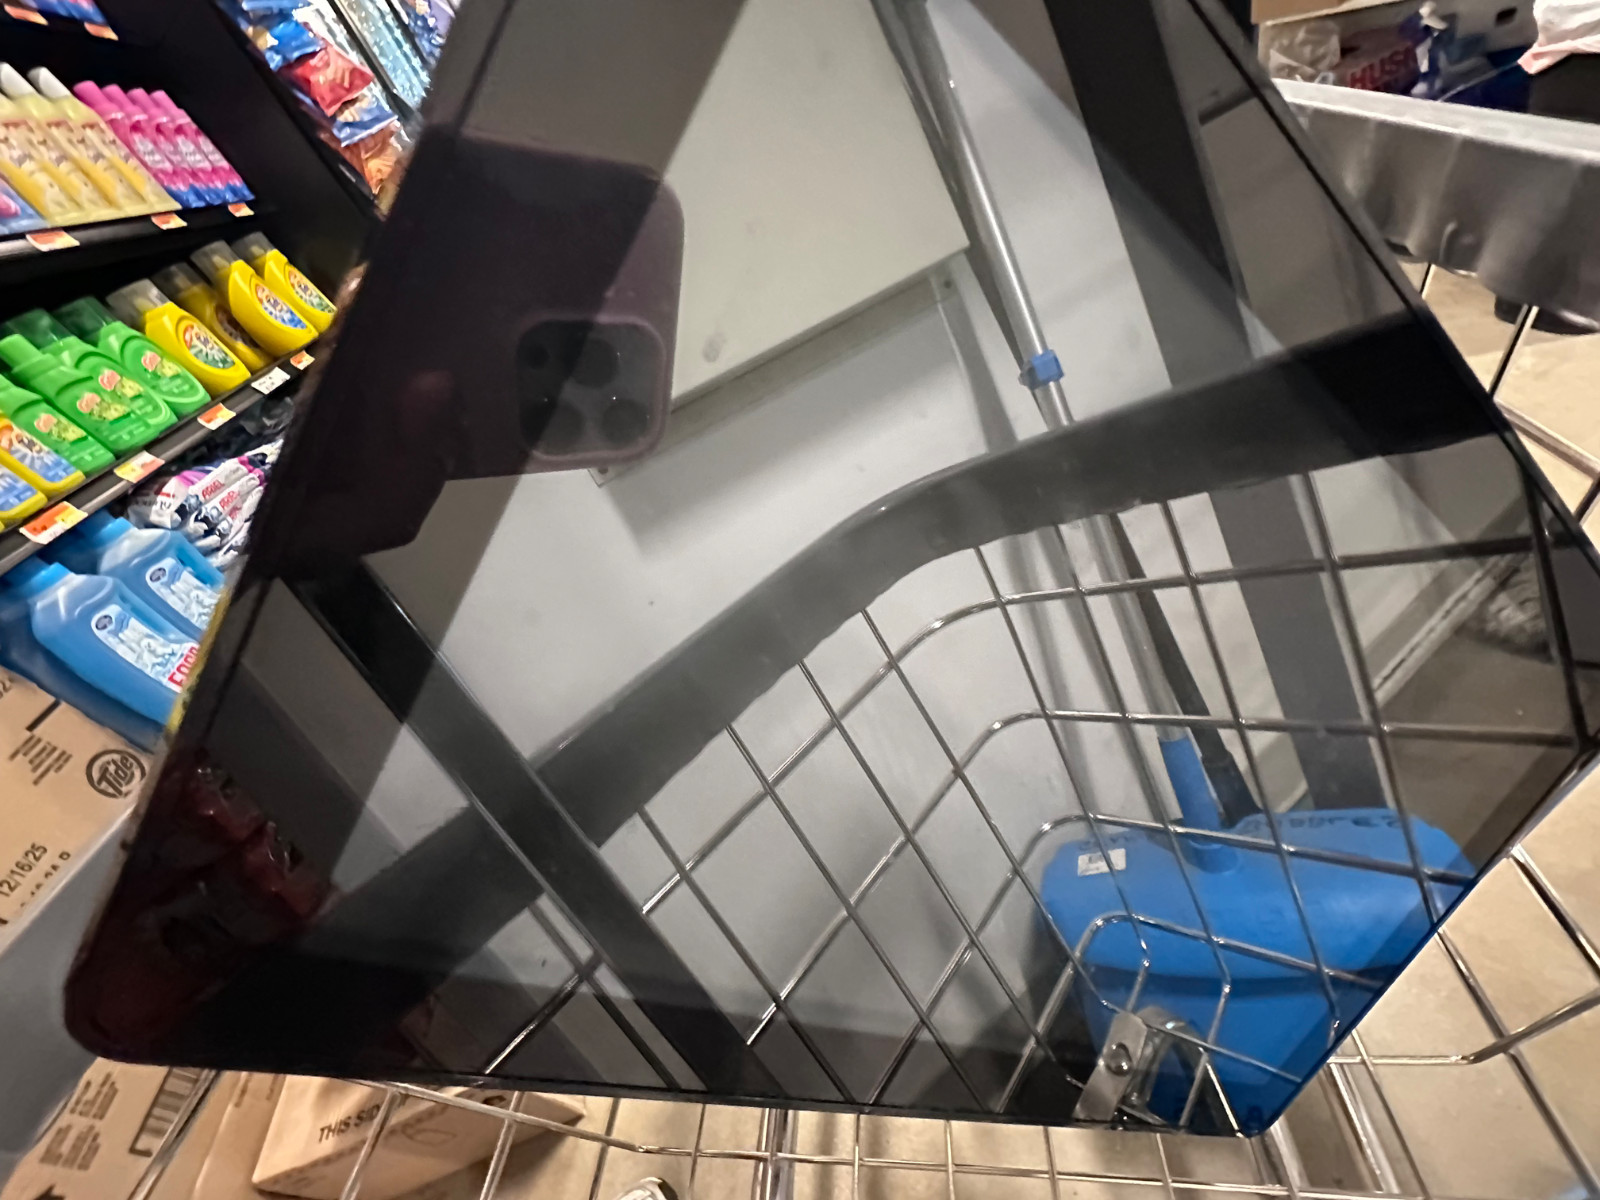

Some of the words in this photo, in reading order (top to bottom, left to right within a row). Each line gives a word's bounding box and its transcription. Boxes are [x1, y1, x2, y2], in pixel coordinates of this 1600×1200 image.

[202, 479, 225, 500] ARIEL
[97, 755, 134, 797] Tide
[0, 842, 48, 898] 12/16/25
[318, 1116, 352, 1143] THIS
[354, 1104, 381, 1128] SID
